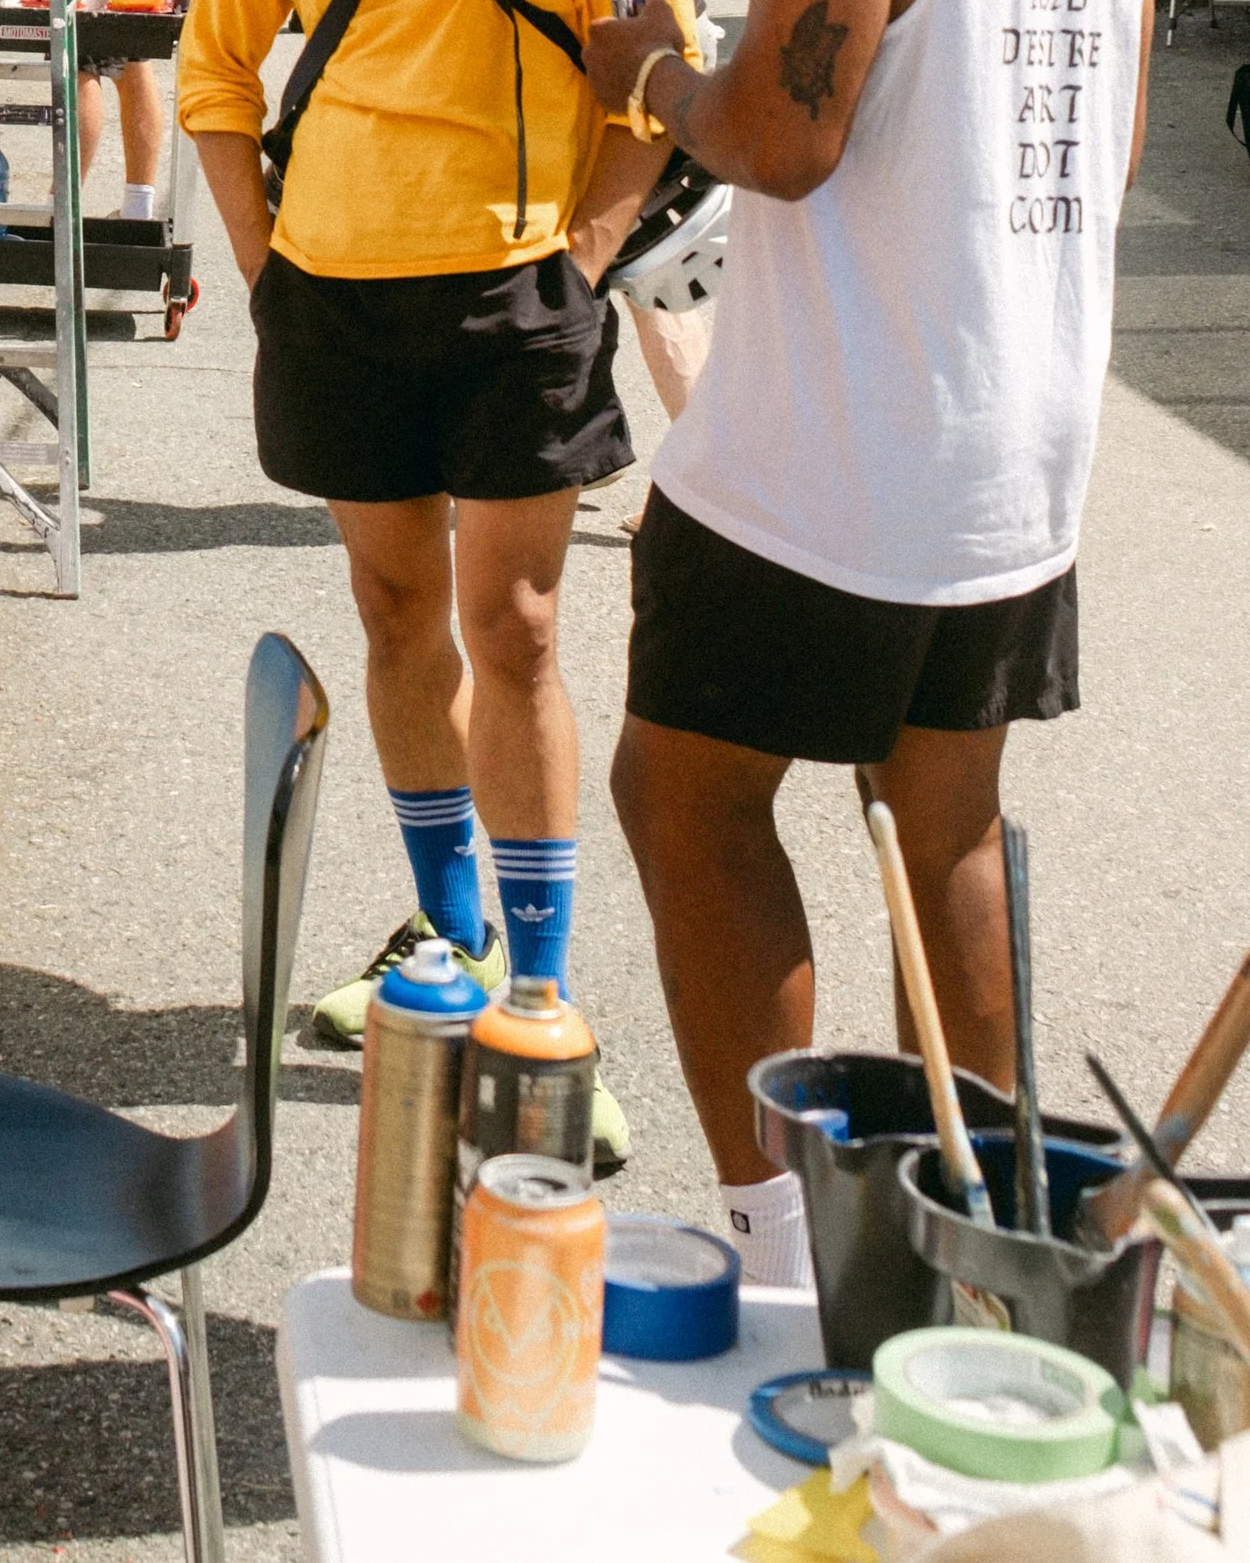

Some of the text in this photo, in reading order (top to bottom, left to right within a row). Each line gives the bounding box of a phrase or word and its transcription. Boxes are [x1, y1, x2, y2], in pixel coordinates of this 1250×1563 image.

[3, 27, 50, 38] MOTOMASTE
[1017, 85, 1082, 123] ART
[1018, 140, 1079, 179] DOT
[1010, 195, 1083, 234] COM
